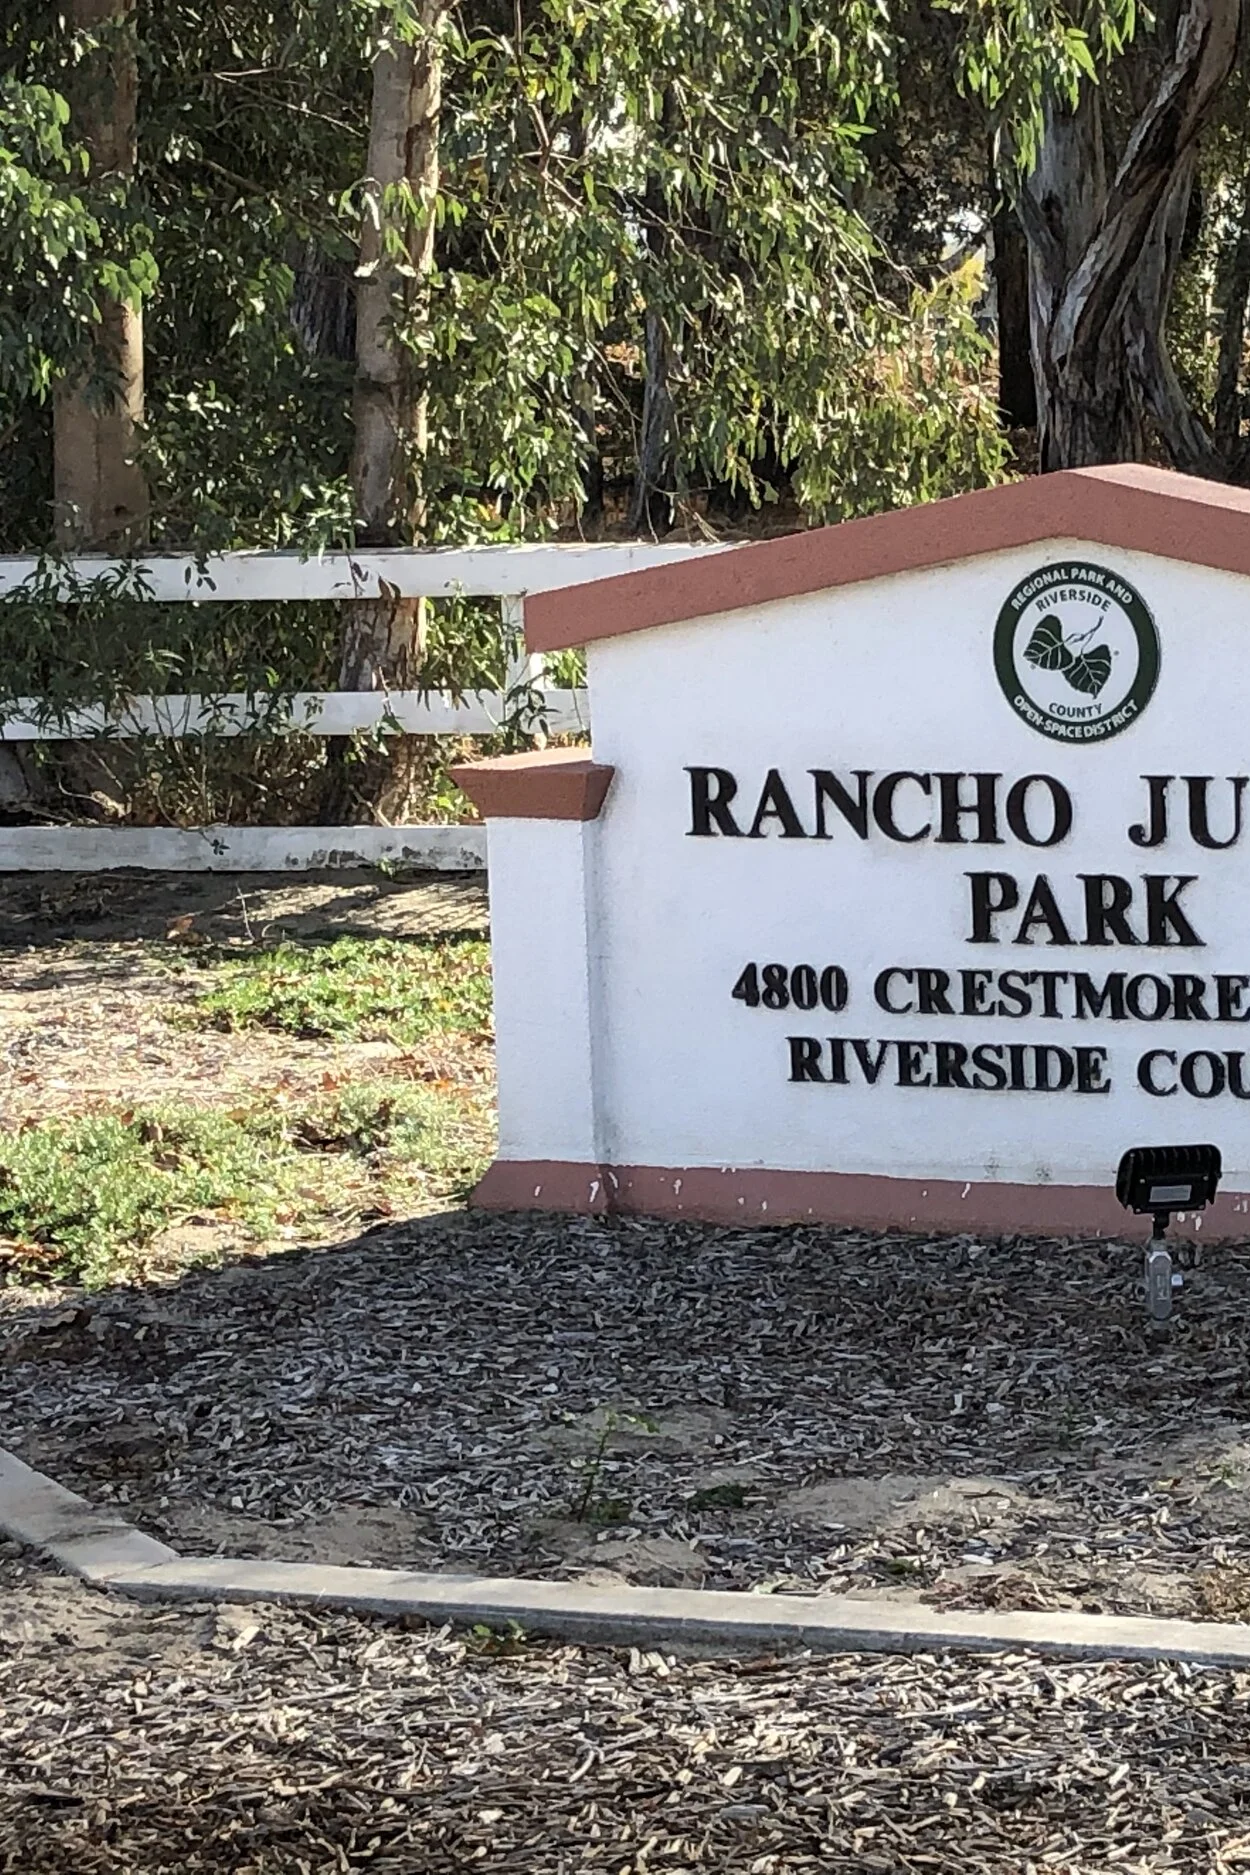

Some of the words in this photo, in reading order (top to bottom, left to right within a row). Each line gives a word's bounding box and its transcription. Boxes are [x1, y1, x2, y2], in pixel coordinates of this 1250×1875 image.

[1011, 568, 1069, 611] REGIONAL
[1070, 567, 1105, 586] PARK
[1105, 580, 1133, 605] AND
[1035, 588, 1112, 613] RIVERSIDE
[1013, 694, 1083, 739] OPEN-SPACE
[1083, 699, 1139, 738] DISTRICT
[1048, 702, 1103, 719] COUNTY
[683, 767, 1073, 848] RANCHO
[963, 871, 1207, 948] PARK
[732, 963, 849, 1012] 4800
[786, 1036, 1112, 1094] RIVERSIDE
